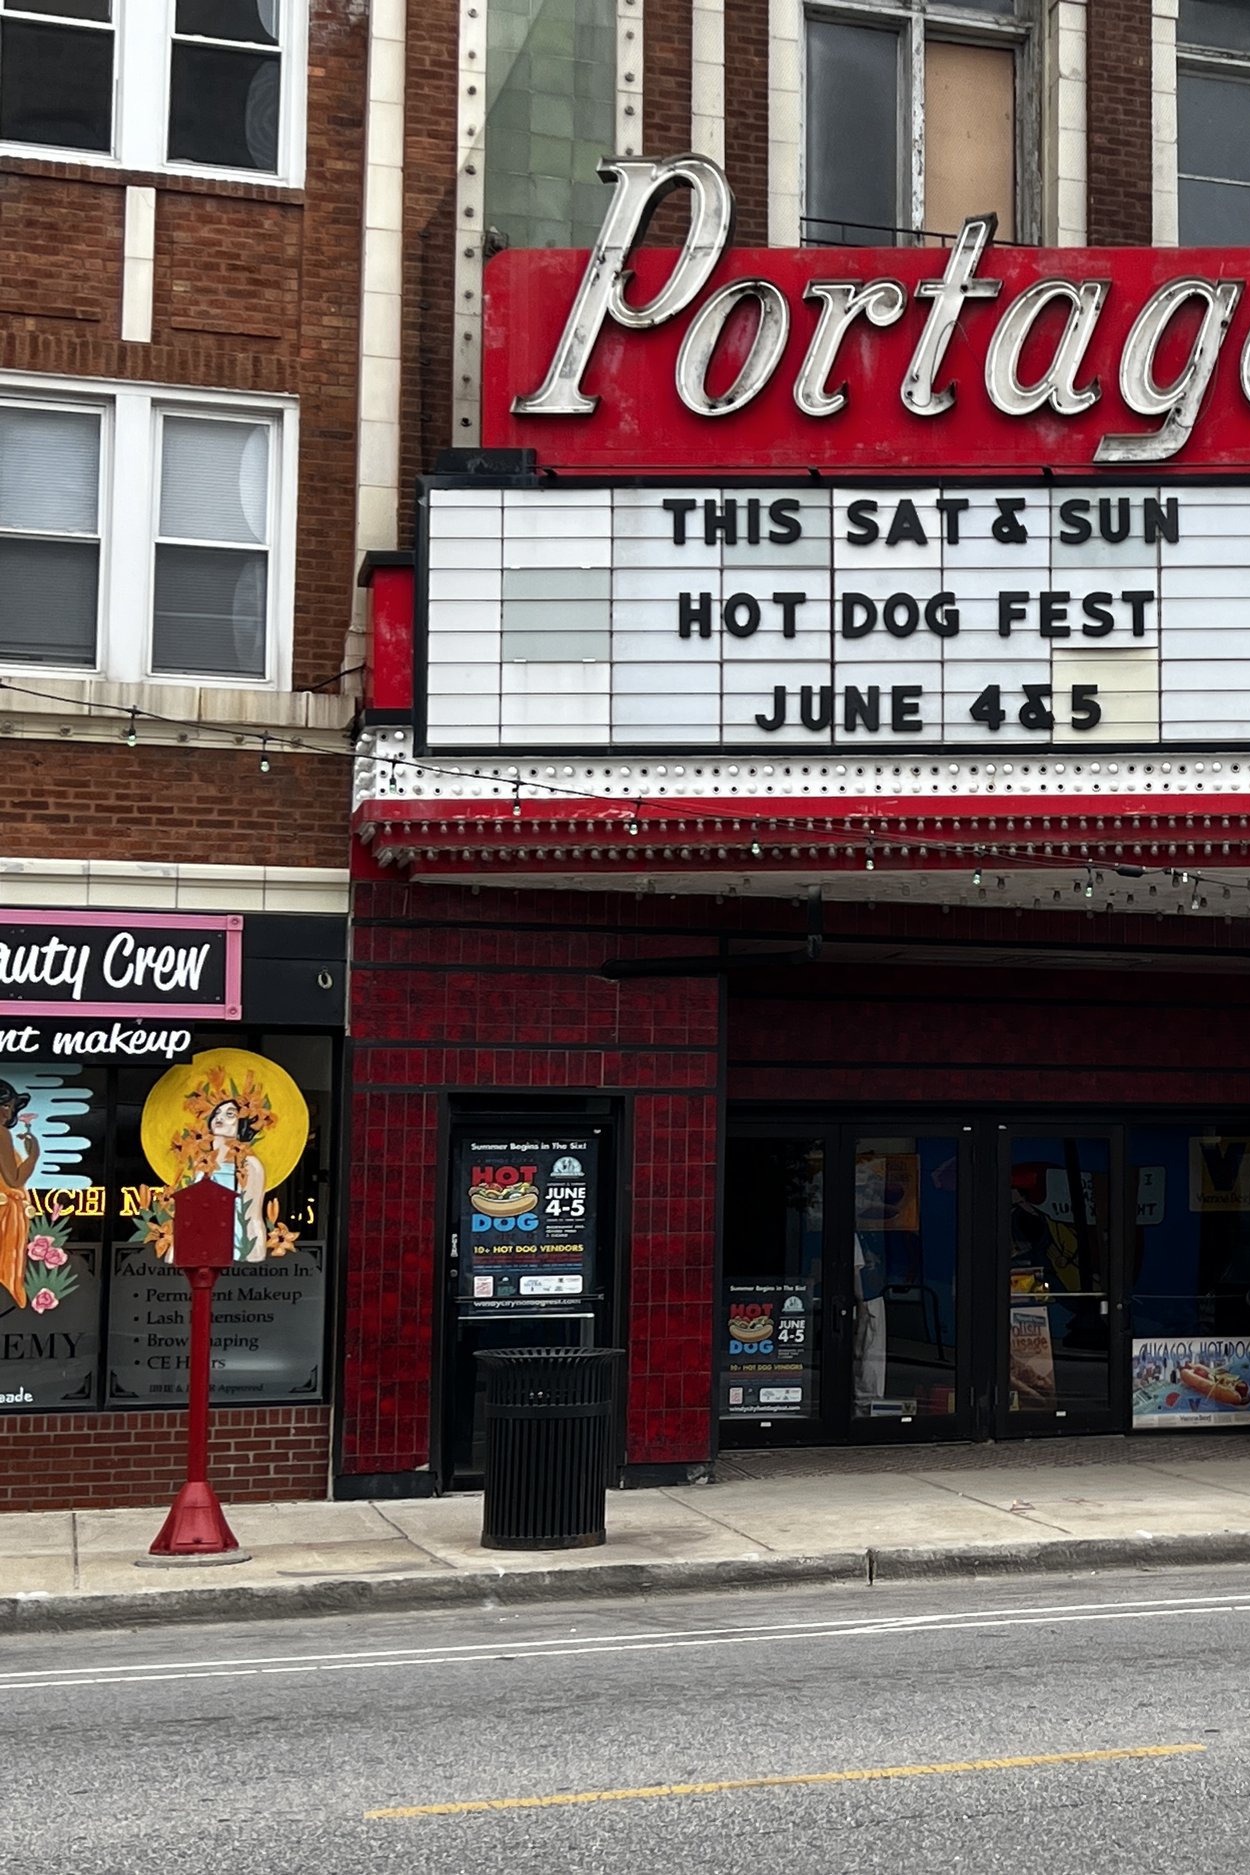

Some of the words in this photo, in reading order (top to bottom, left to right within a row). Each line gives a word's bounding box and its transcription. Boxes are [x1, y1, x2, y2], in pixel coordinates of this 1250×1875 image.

[662, 498, 801, 546] THIS
[847, 498, 969, 546] SAT
[992, 497, 1028, 545] &
[1060, 497, 1180, 546] SUN
[679, 592, 807, 639] HOT
[842, 592, 960, 640] DOG
[998, 590, 1155, 638] FEST
[756, 685, 924, 732] JUNE
[104, 932, 210, 991] Crew
[54, 1022, 191, 1059] makeup
[471, 1166, 538, 1186] HOT
[544, 1187, 587, 1200] JUNE
[544, 1199, 586, 1217] 4-5
[471, 1213, 540, 1233] DOG
[473, 1246, 491, 1254] 10+
[493, 1245, 513, 1253] HOT
[515, 1245, 538, 1254] DOG
[539, 1244, 584, 1253] VENDORS
[122, 1263, 190, 1277] Advanc
[220, 1263, 288, 1277] ducation
[147, 1288, 232, 1302] Permaent
[238, 1288, 302, 1304] Makeup
[147, 1311, 184, 1325] Lash
[729, 1303, 773, 1318] HOT
[778, 1319, 806, 1330] JUNE
[147, 1333, 189, 1347] Brow
[208, 1334, 259, 1351] aping
[778, 1329, 805, 1343] 4-5
[728, 1339, 775, 1355] DOG
[1199, 1342, 1223, 1360] HOT
[147, 1356, 171, 1369] CE
[176, 1356, 226, 1369] Hrs
